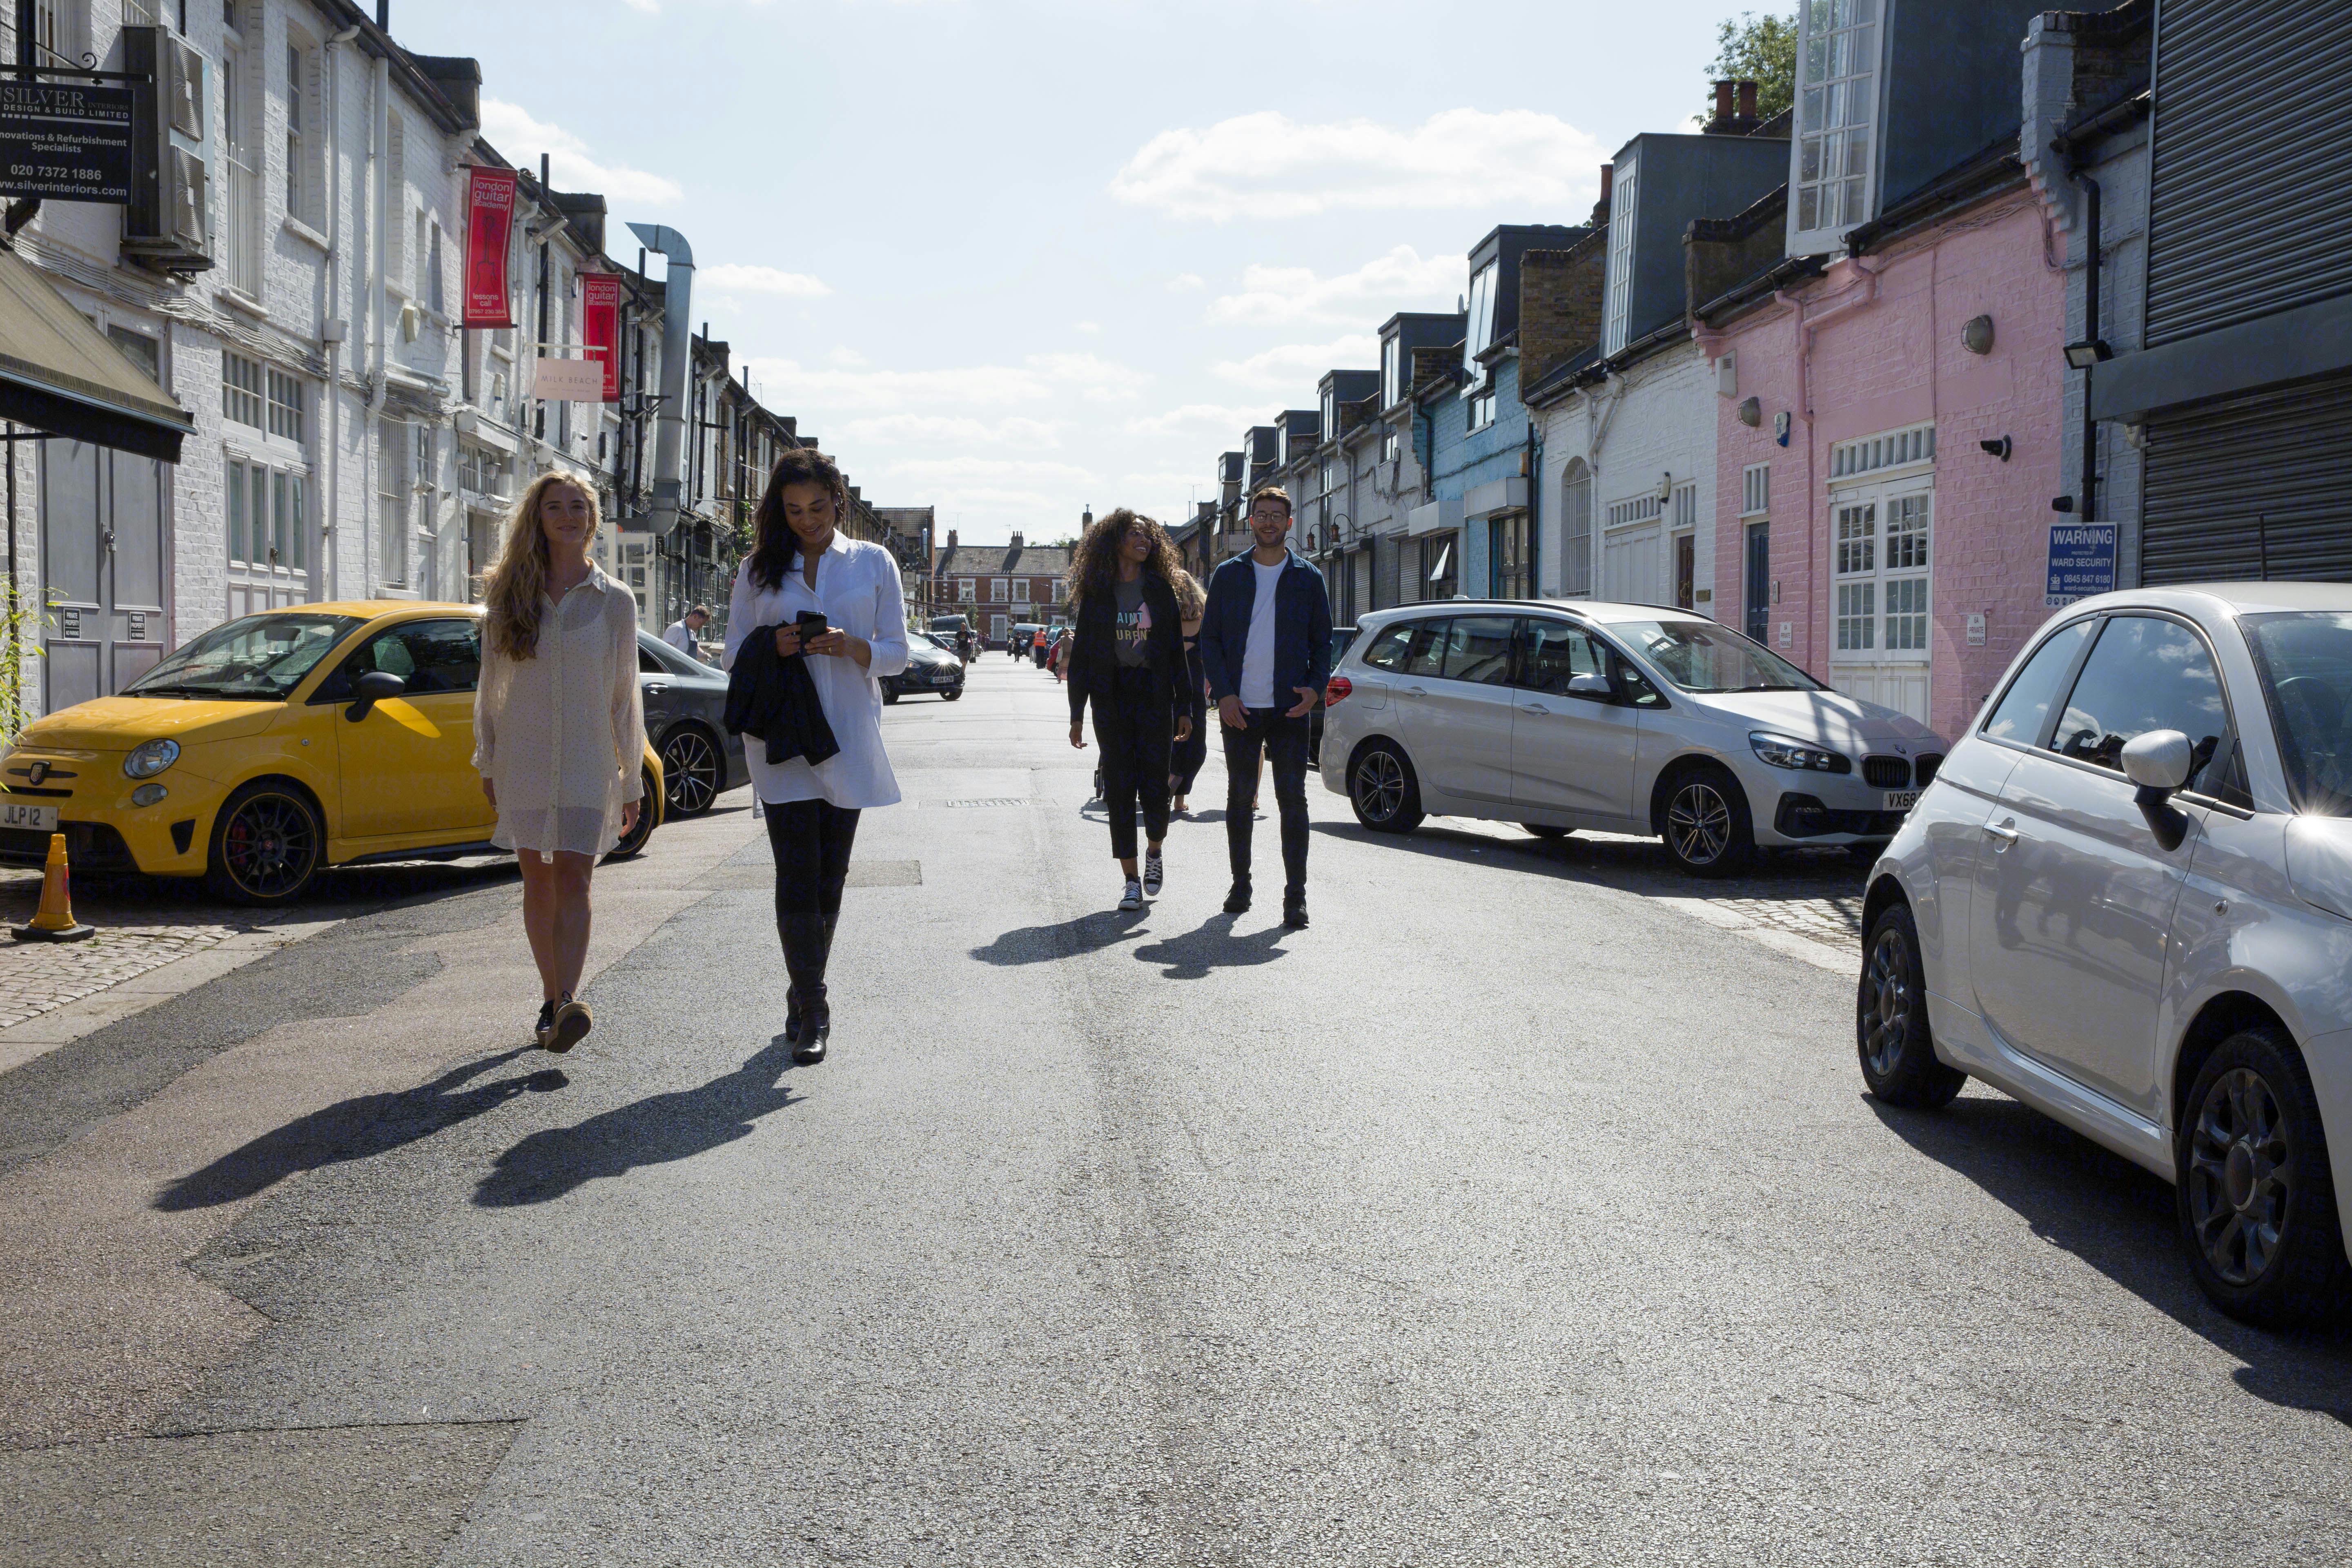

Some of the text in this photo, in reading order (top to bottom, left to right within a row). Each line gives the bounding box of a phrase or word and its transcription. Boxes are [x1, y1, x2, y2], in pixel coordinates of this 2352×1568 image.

[4, 87, 129, 111] SILVER INTERIORS
[4, 104, 40, 112] DESIGN
[89, 110, 128, 118] LIMITED
[0, 132, 45, 140] novations
[57, 134, 127, 147] Refurbishment
[32, 142, 81, 153] Specialists
[11, 165, 102, 180] 020 7372 1886
[476, 180, 510, 192] london
[474, 190, 509, 202] guitar
[474, 200, 508, 211] academy
[588, 291, 615, 301] guitar
[569, 376, 597, 385] BEACH
[2053, 529, 2112, 545] WARNING
[2051, 558, 2111, 567] WARD SECURITY
[2064, 575, 2111, 584] 0845 847 6180
[1889, 793, 1916, 807] VX68
[4, 806, 40, 825] JLP 12
